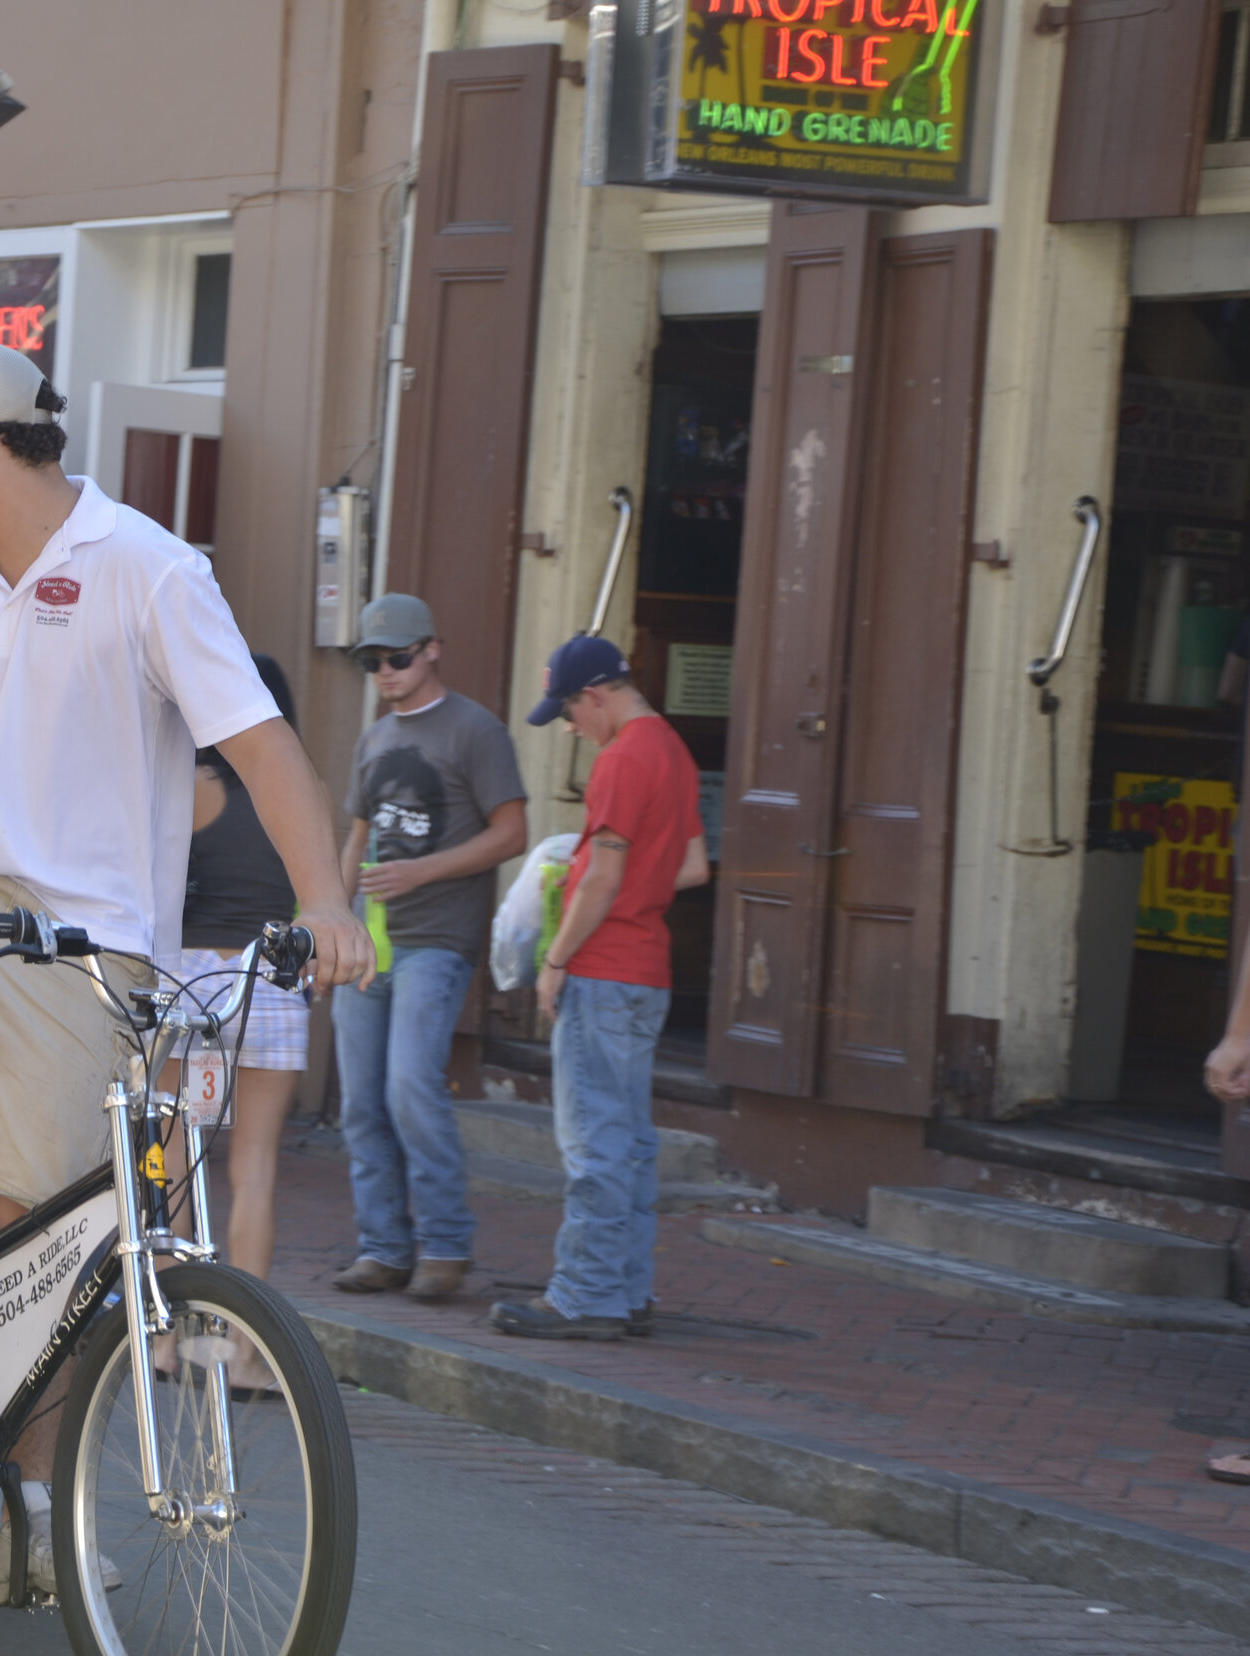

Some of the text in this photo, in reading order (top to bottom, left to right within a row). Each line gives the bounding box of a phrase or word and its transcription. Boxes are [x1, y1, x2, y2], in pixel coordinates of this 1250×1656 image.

[776, 27, 891, 87] ISLE
[699, 99, 954, 151] HAND GRENADE
[202, 1070, 216, 1101] 3
[27, 1260, 37, 1279] A
